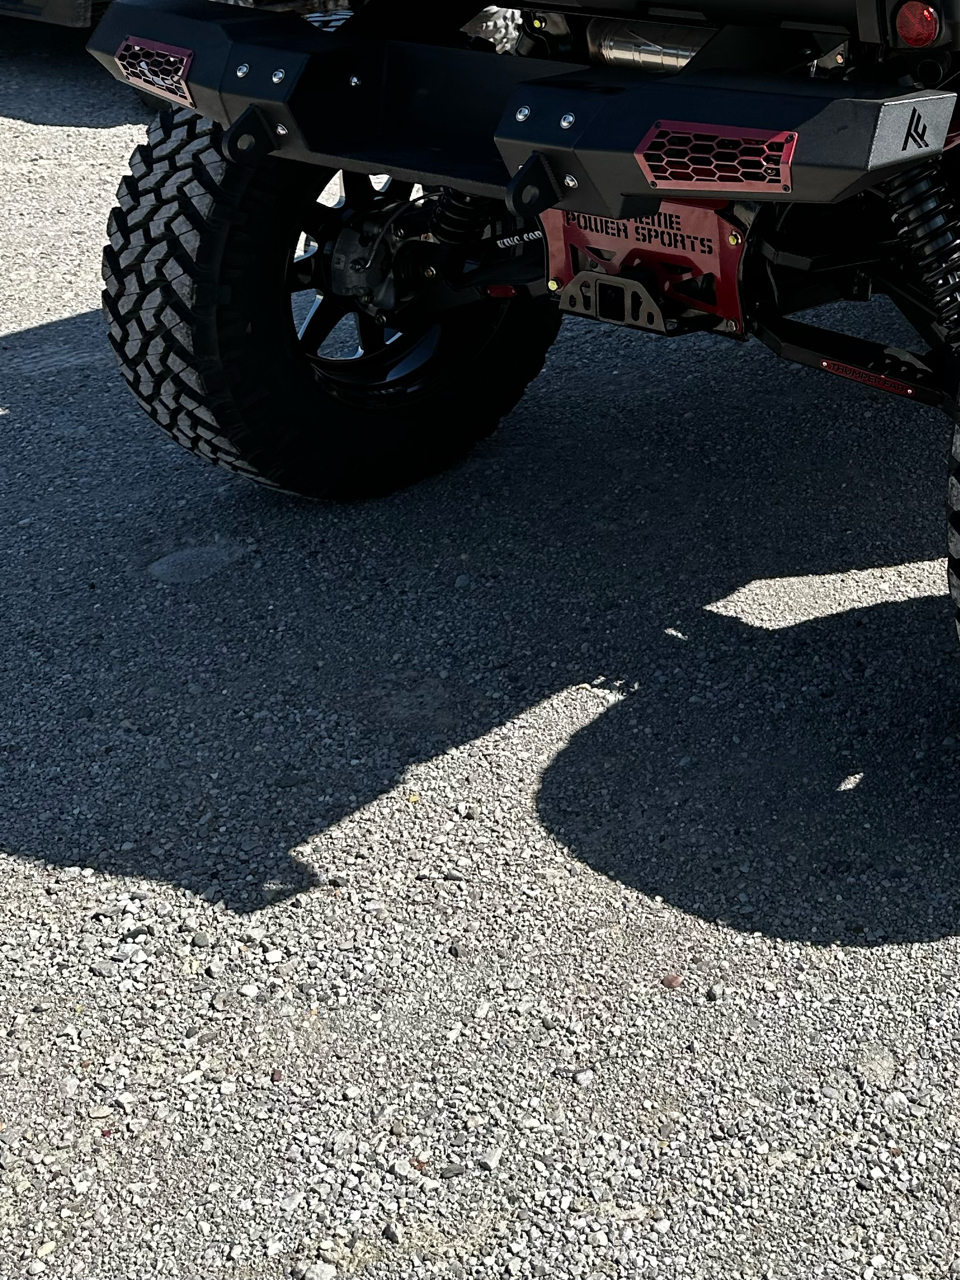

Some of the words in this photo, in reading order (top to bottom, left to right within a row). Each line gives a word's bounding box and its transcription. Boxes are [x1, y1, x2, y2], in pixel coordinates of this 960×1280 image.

[566, 211, 628, 239] POWER
[635, 226, 713, 254] SPORTS
[830, 362, 881, 384] THUMPER
[883, 378, 905, 392] FAB
